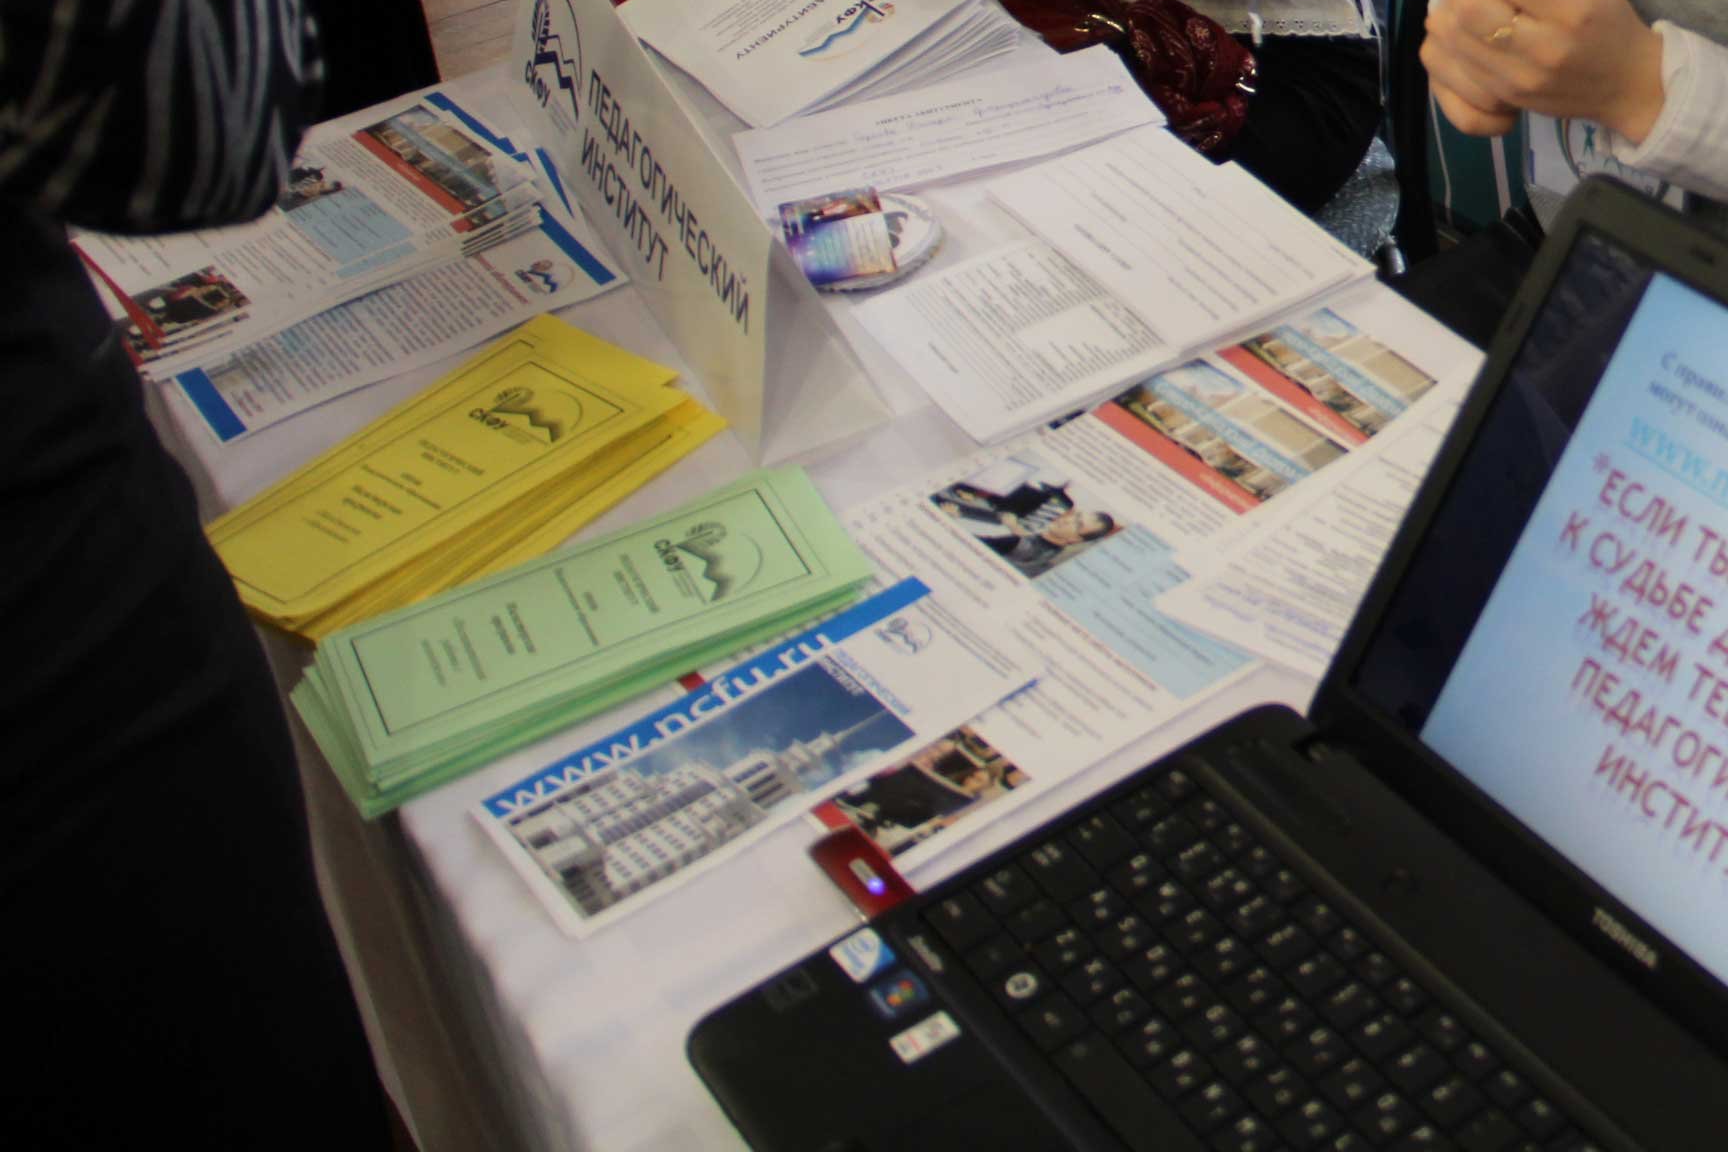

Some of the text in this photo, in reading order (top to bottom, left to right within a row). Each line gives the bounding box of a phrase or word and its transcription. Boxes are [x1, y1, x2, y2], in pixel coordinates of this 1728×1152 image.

[525, 60, 551, 108] СКФУ
[581, 128, 669, 282] ИНСТИТУТ
[589, 69, 750, 336] ПЕДАГОГИЧЕСКИЙ
[1559, 511, 1590, 552] К
[1590, 531, 1715, 635] СУДЬБЕ
[1577, 591, 1681, 684] ЖДЕМ
[496, 631, 838, 811] www.ncfu.ru
